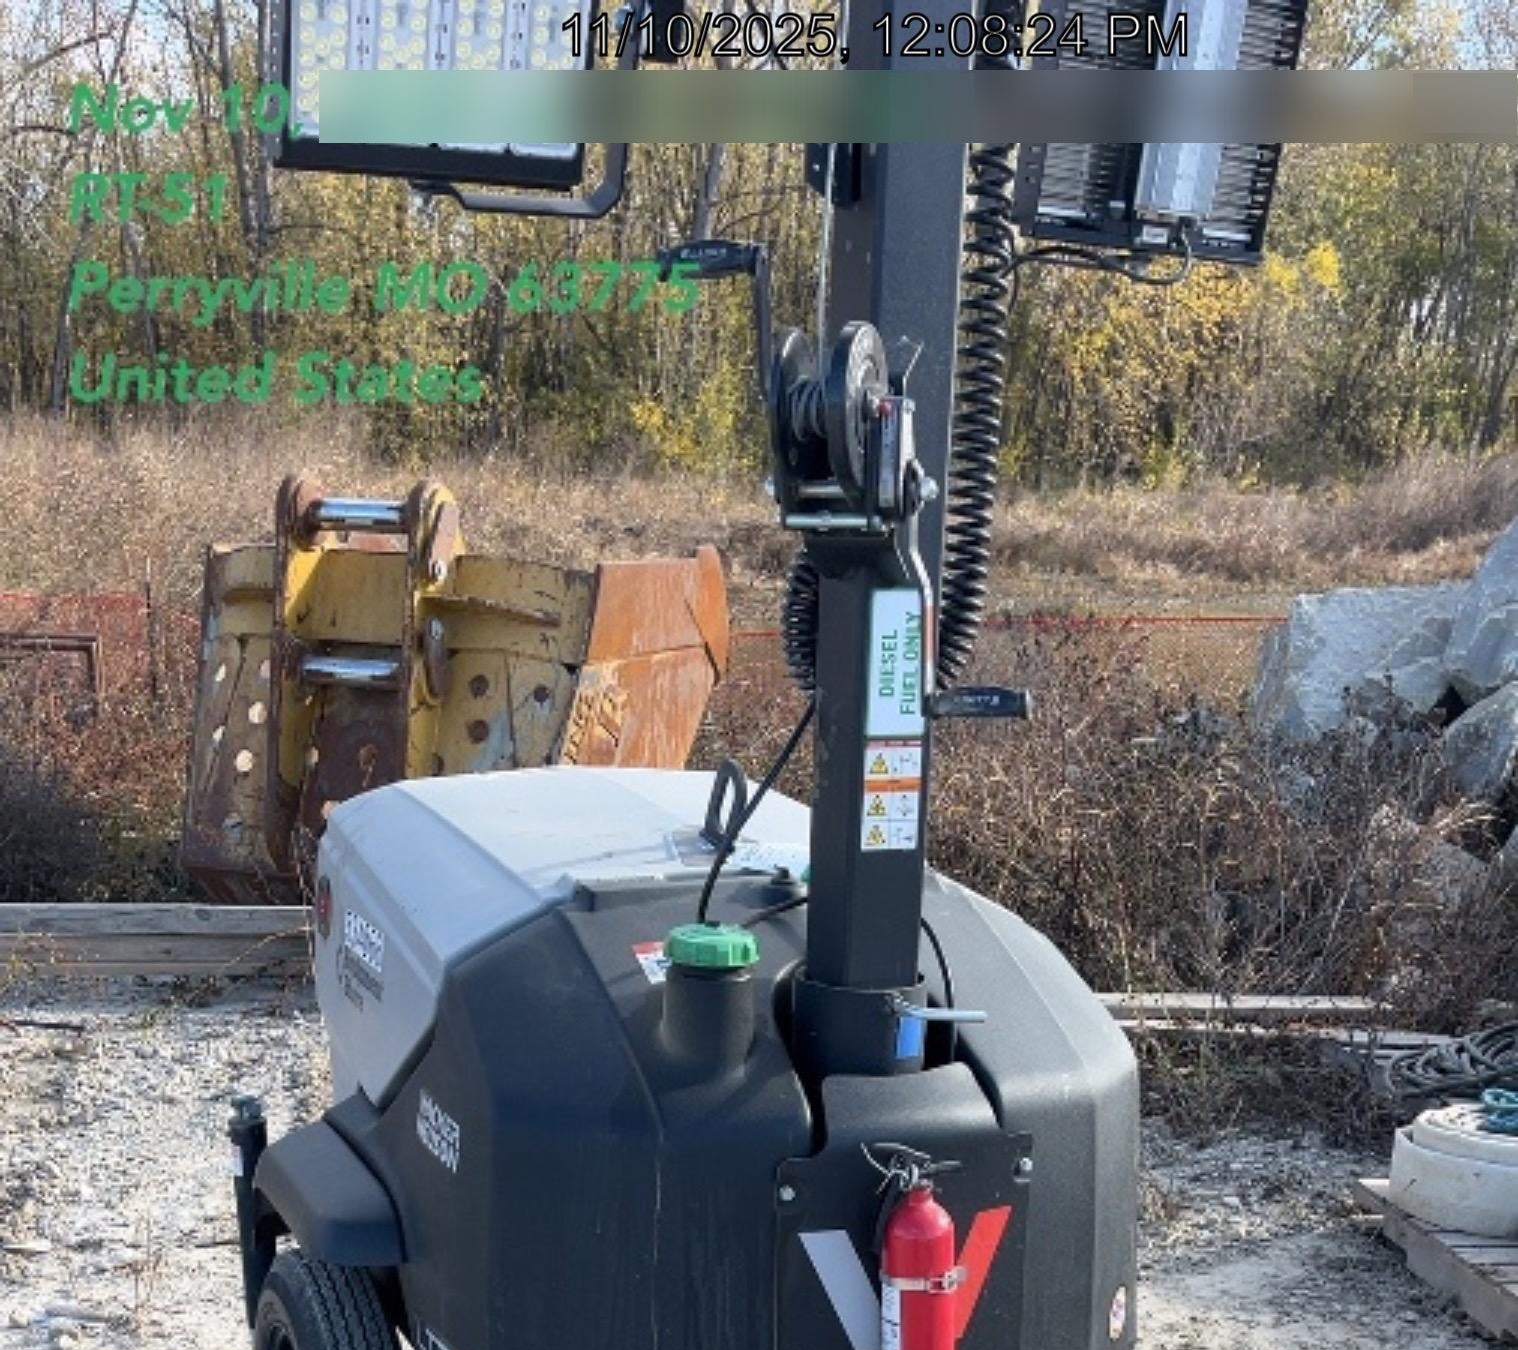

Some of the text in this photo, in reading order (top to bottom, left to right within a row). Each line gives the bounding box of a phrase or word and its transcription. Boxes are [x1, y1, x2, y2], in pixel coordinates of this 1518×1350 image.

[879, 629, 898, 696] DIESEL
[899, 611, 920, 714] FUEL ONLY
